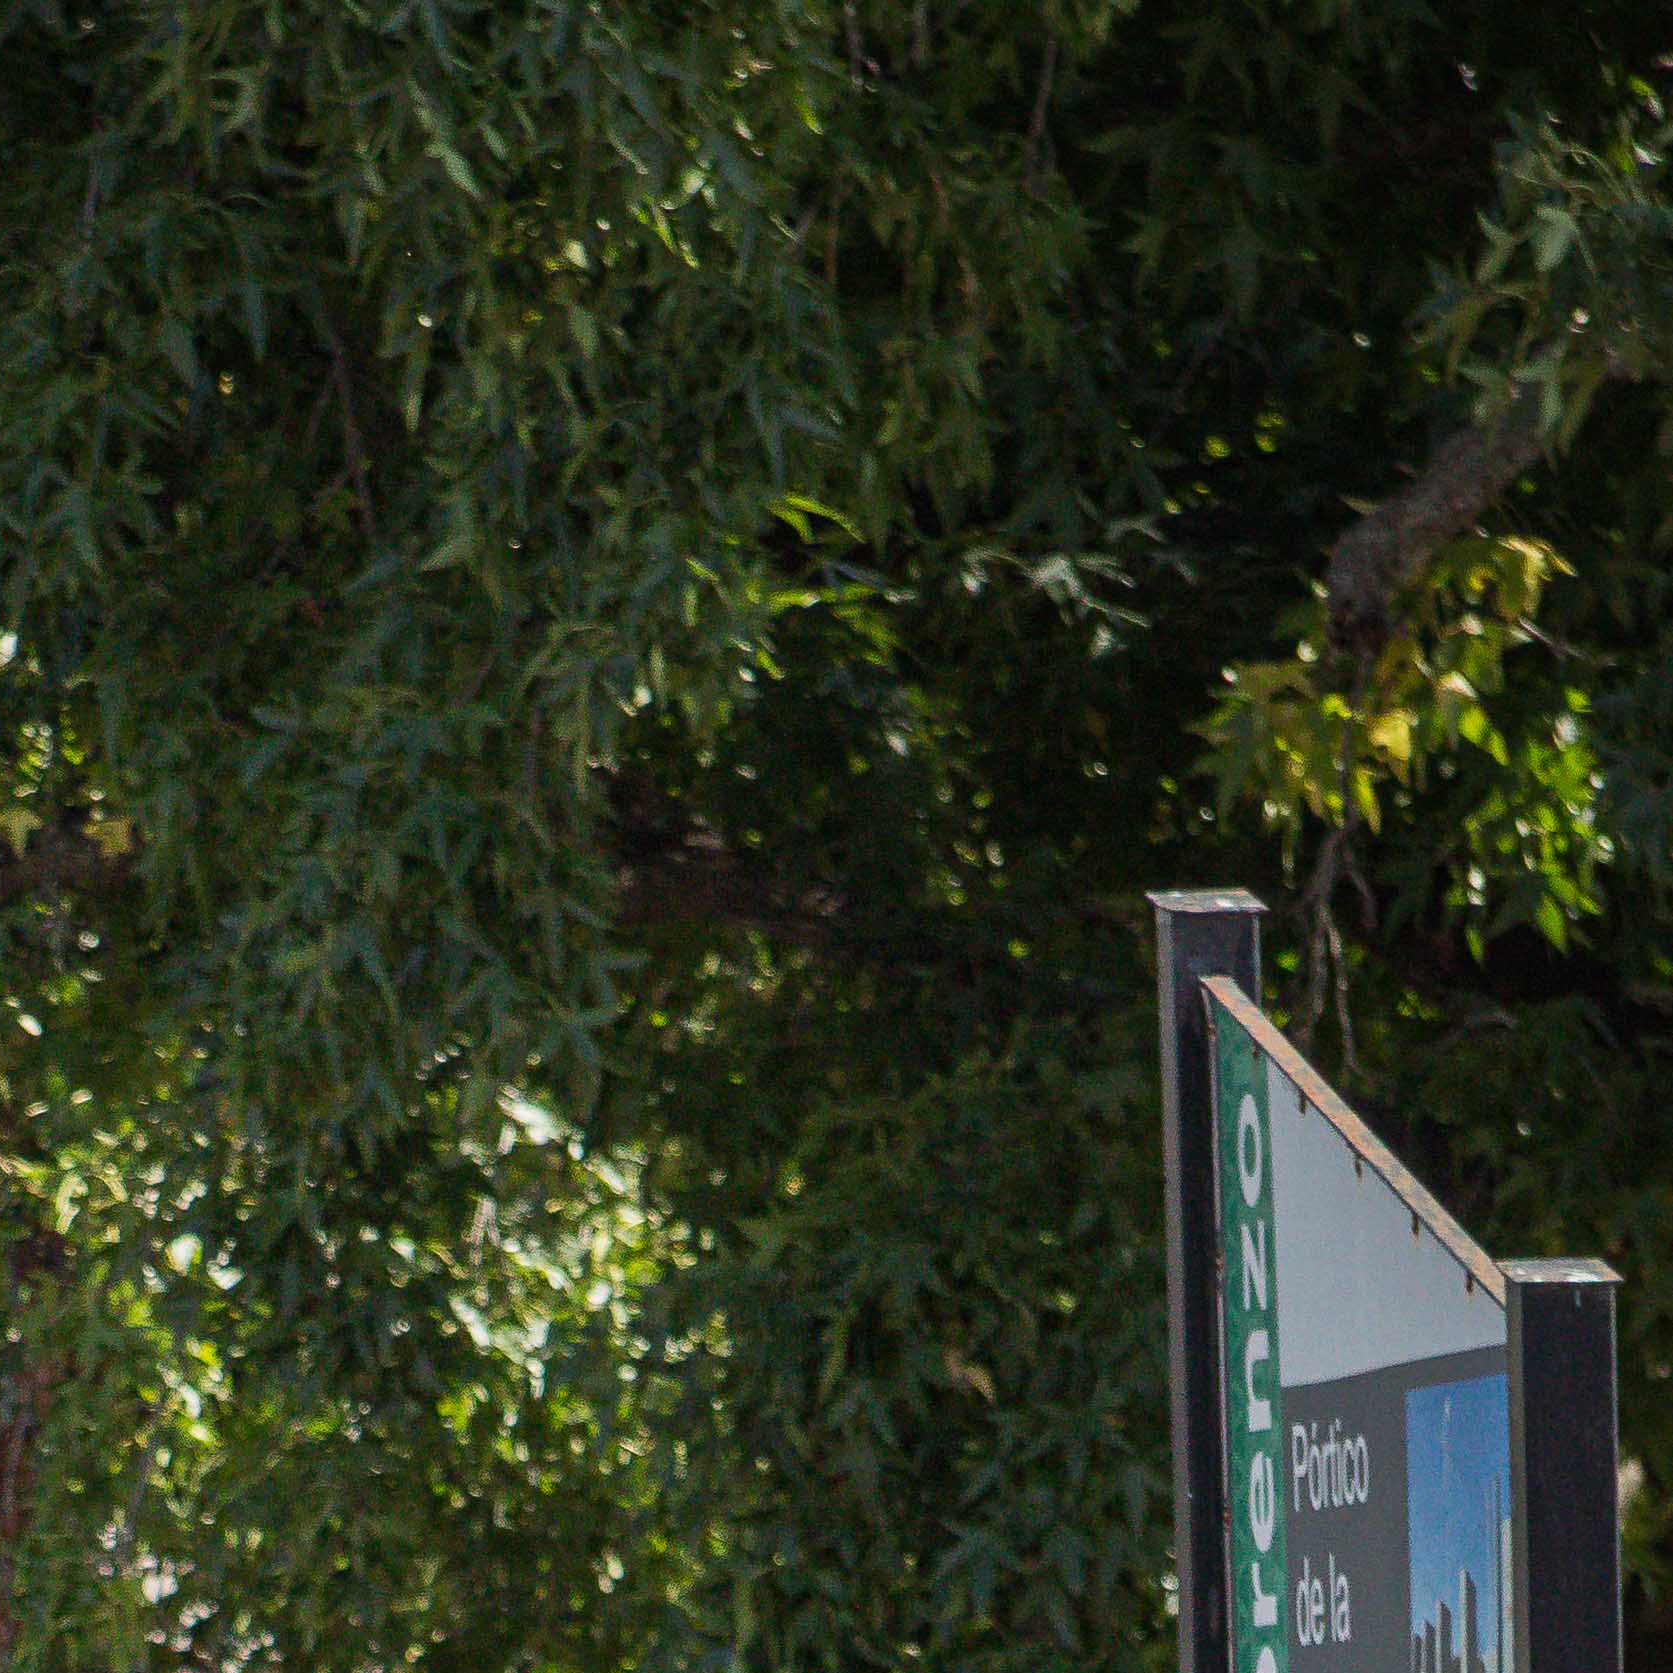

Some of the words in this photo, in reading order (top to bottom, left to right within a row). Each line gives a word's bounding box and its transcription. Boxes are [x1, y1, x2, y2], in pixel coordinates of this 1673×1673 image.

[1291, 1419, 1370, 1512] Pórtico
[1296, 1556, 1325, 1647] de
[1329, 1553, 1351, 1643] la
